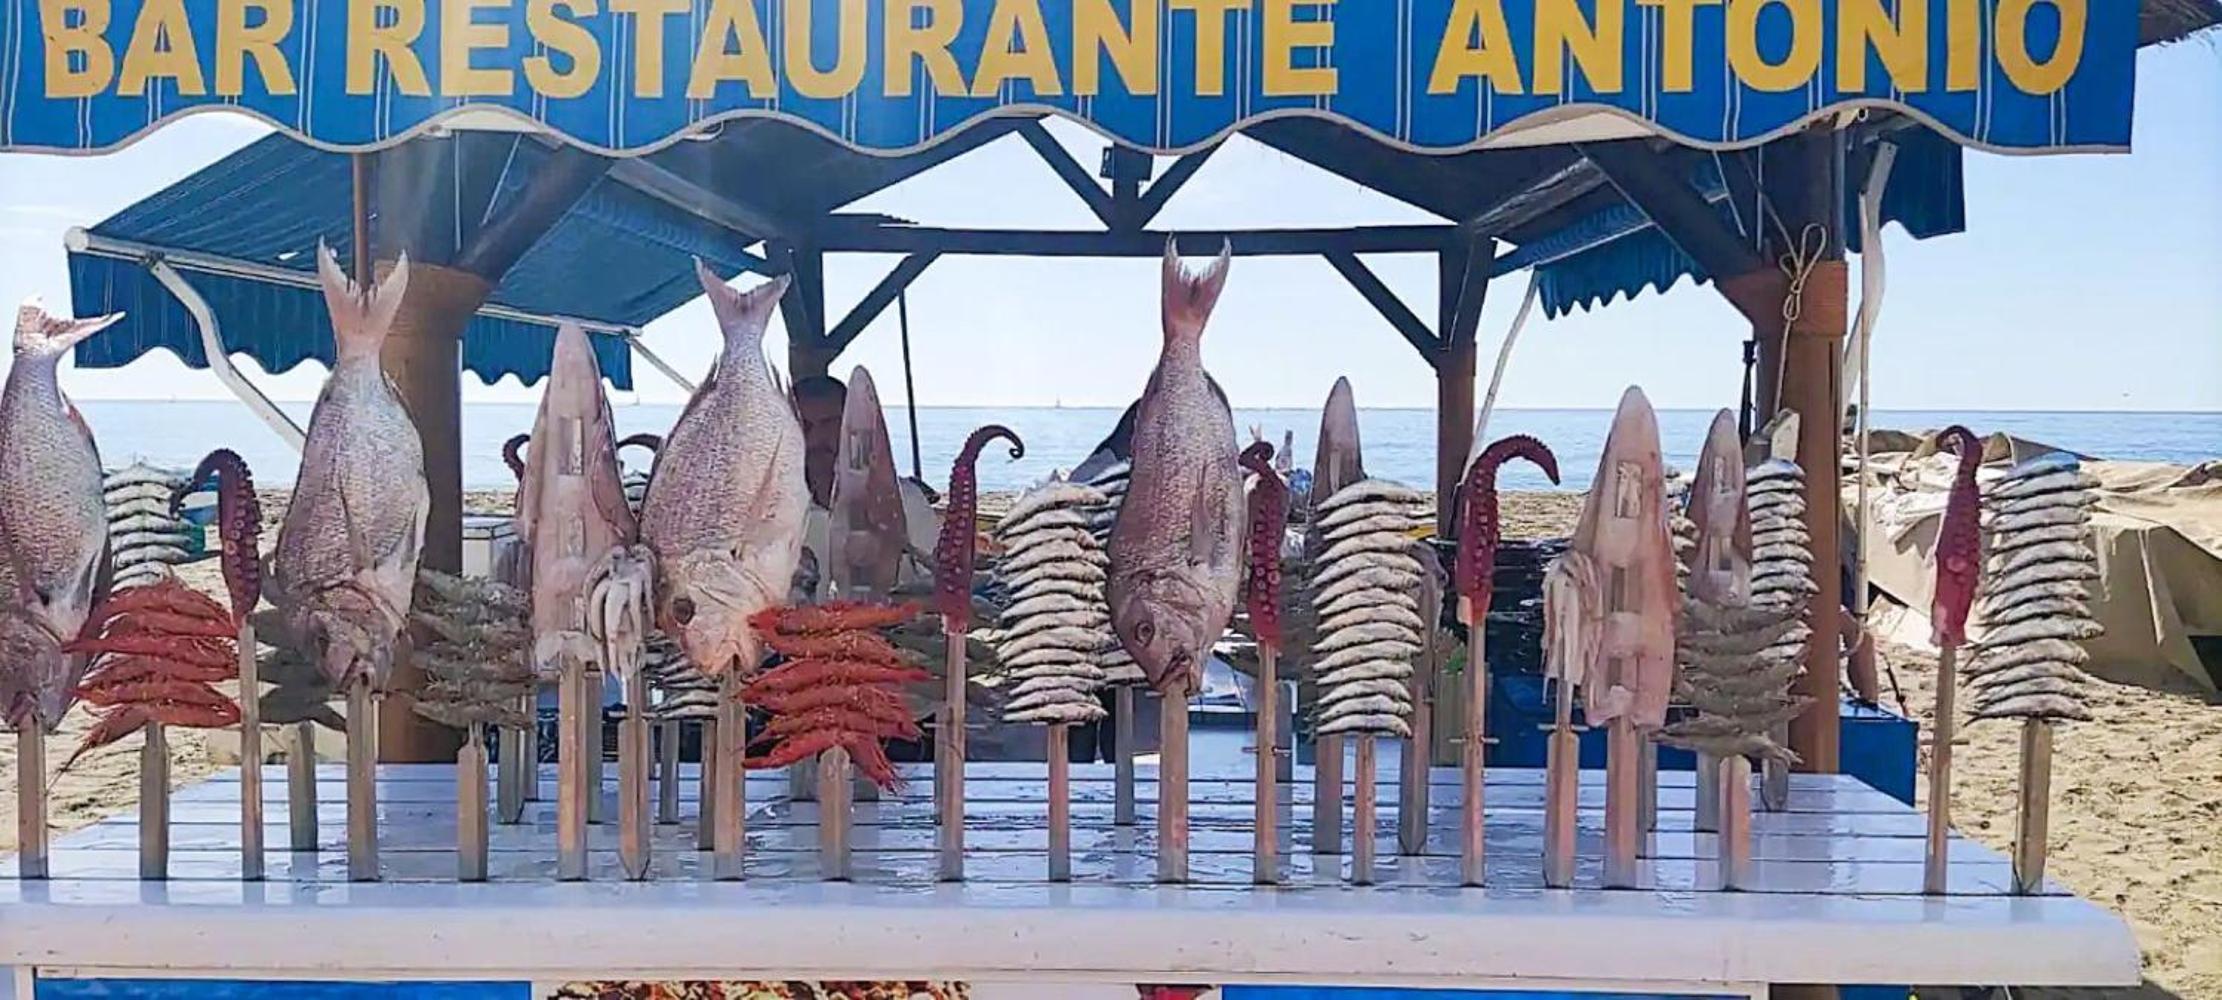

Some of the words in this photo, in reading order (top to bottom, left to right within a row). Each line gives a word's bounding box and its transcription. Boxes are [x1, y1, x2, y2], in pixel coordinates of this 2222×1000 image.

[43, 0, 296, 98] BAR
[346, 0, 1338, 98] RESTAURANTE
[1428, 0, 2088, 95] ANTONIO
